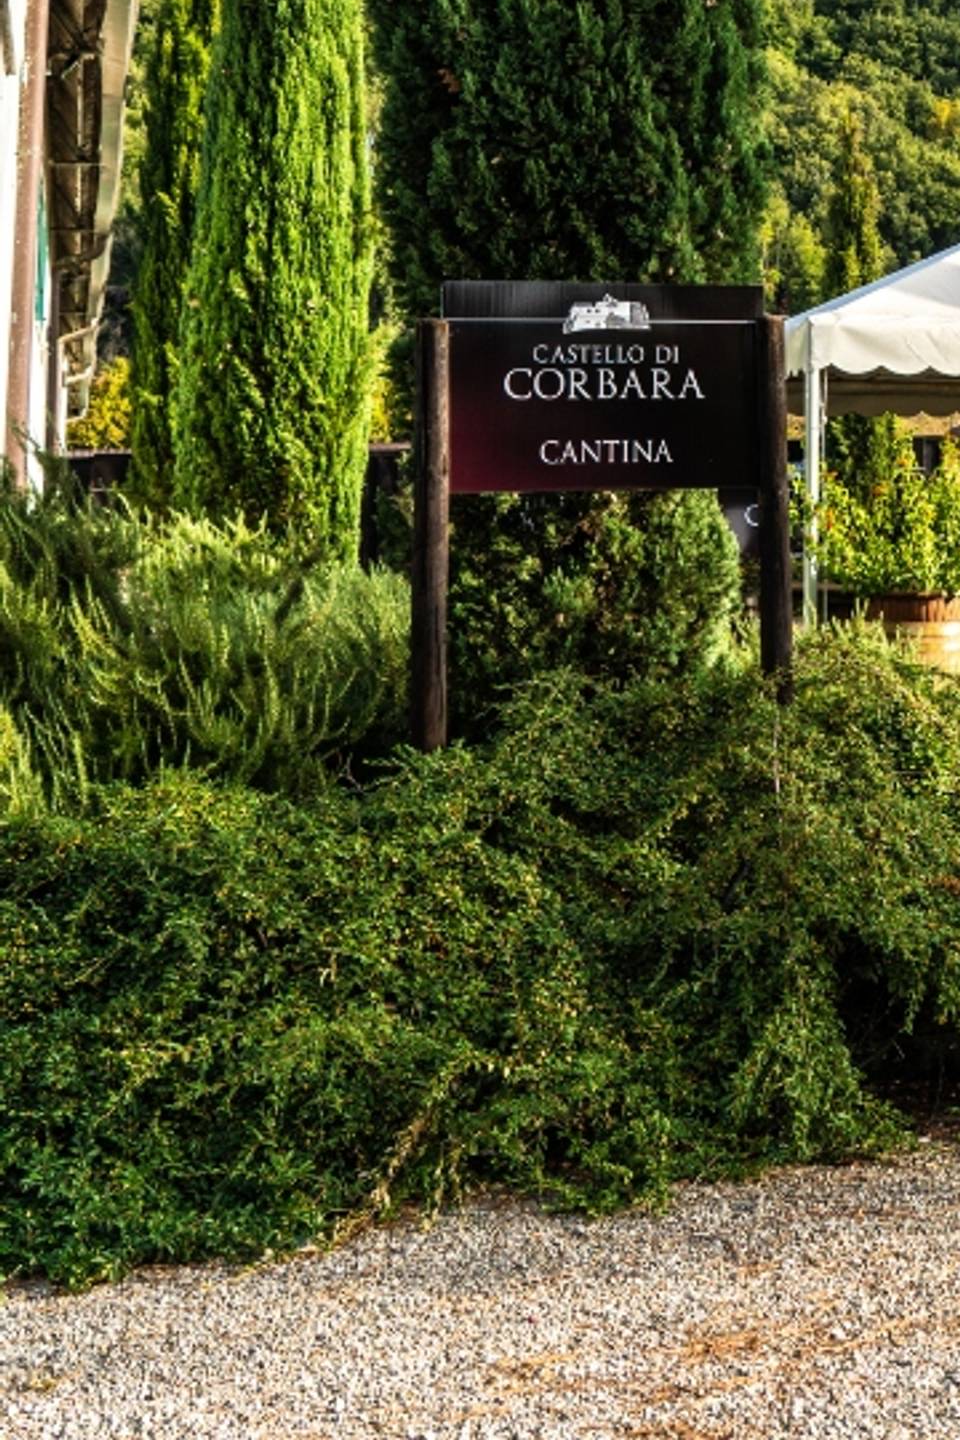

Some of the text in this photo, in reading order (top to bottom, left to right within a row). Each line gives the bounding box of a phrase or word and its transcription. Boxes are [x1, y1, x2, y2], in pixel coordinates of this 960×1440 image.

[532, 344, 679, 364] CASTELLO DI
[503, 368, 706, 400] CORBARA
[539, 439, 673, 465] CANTINA
